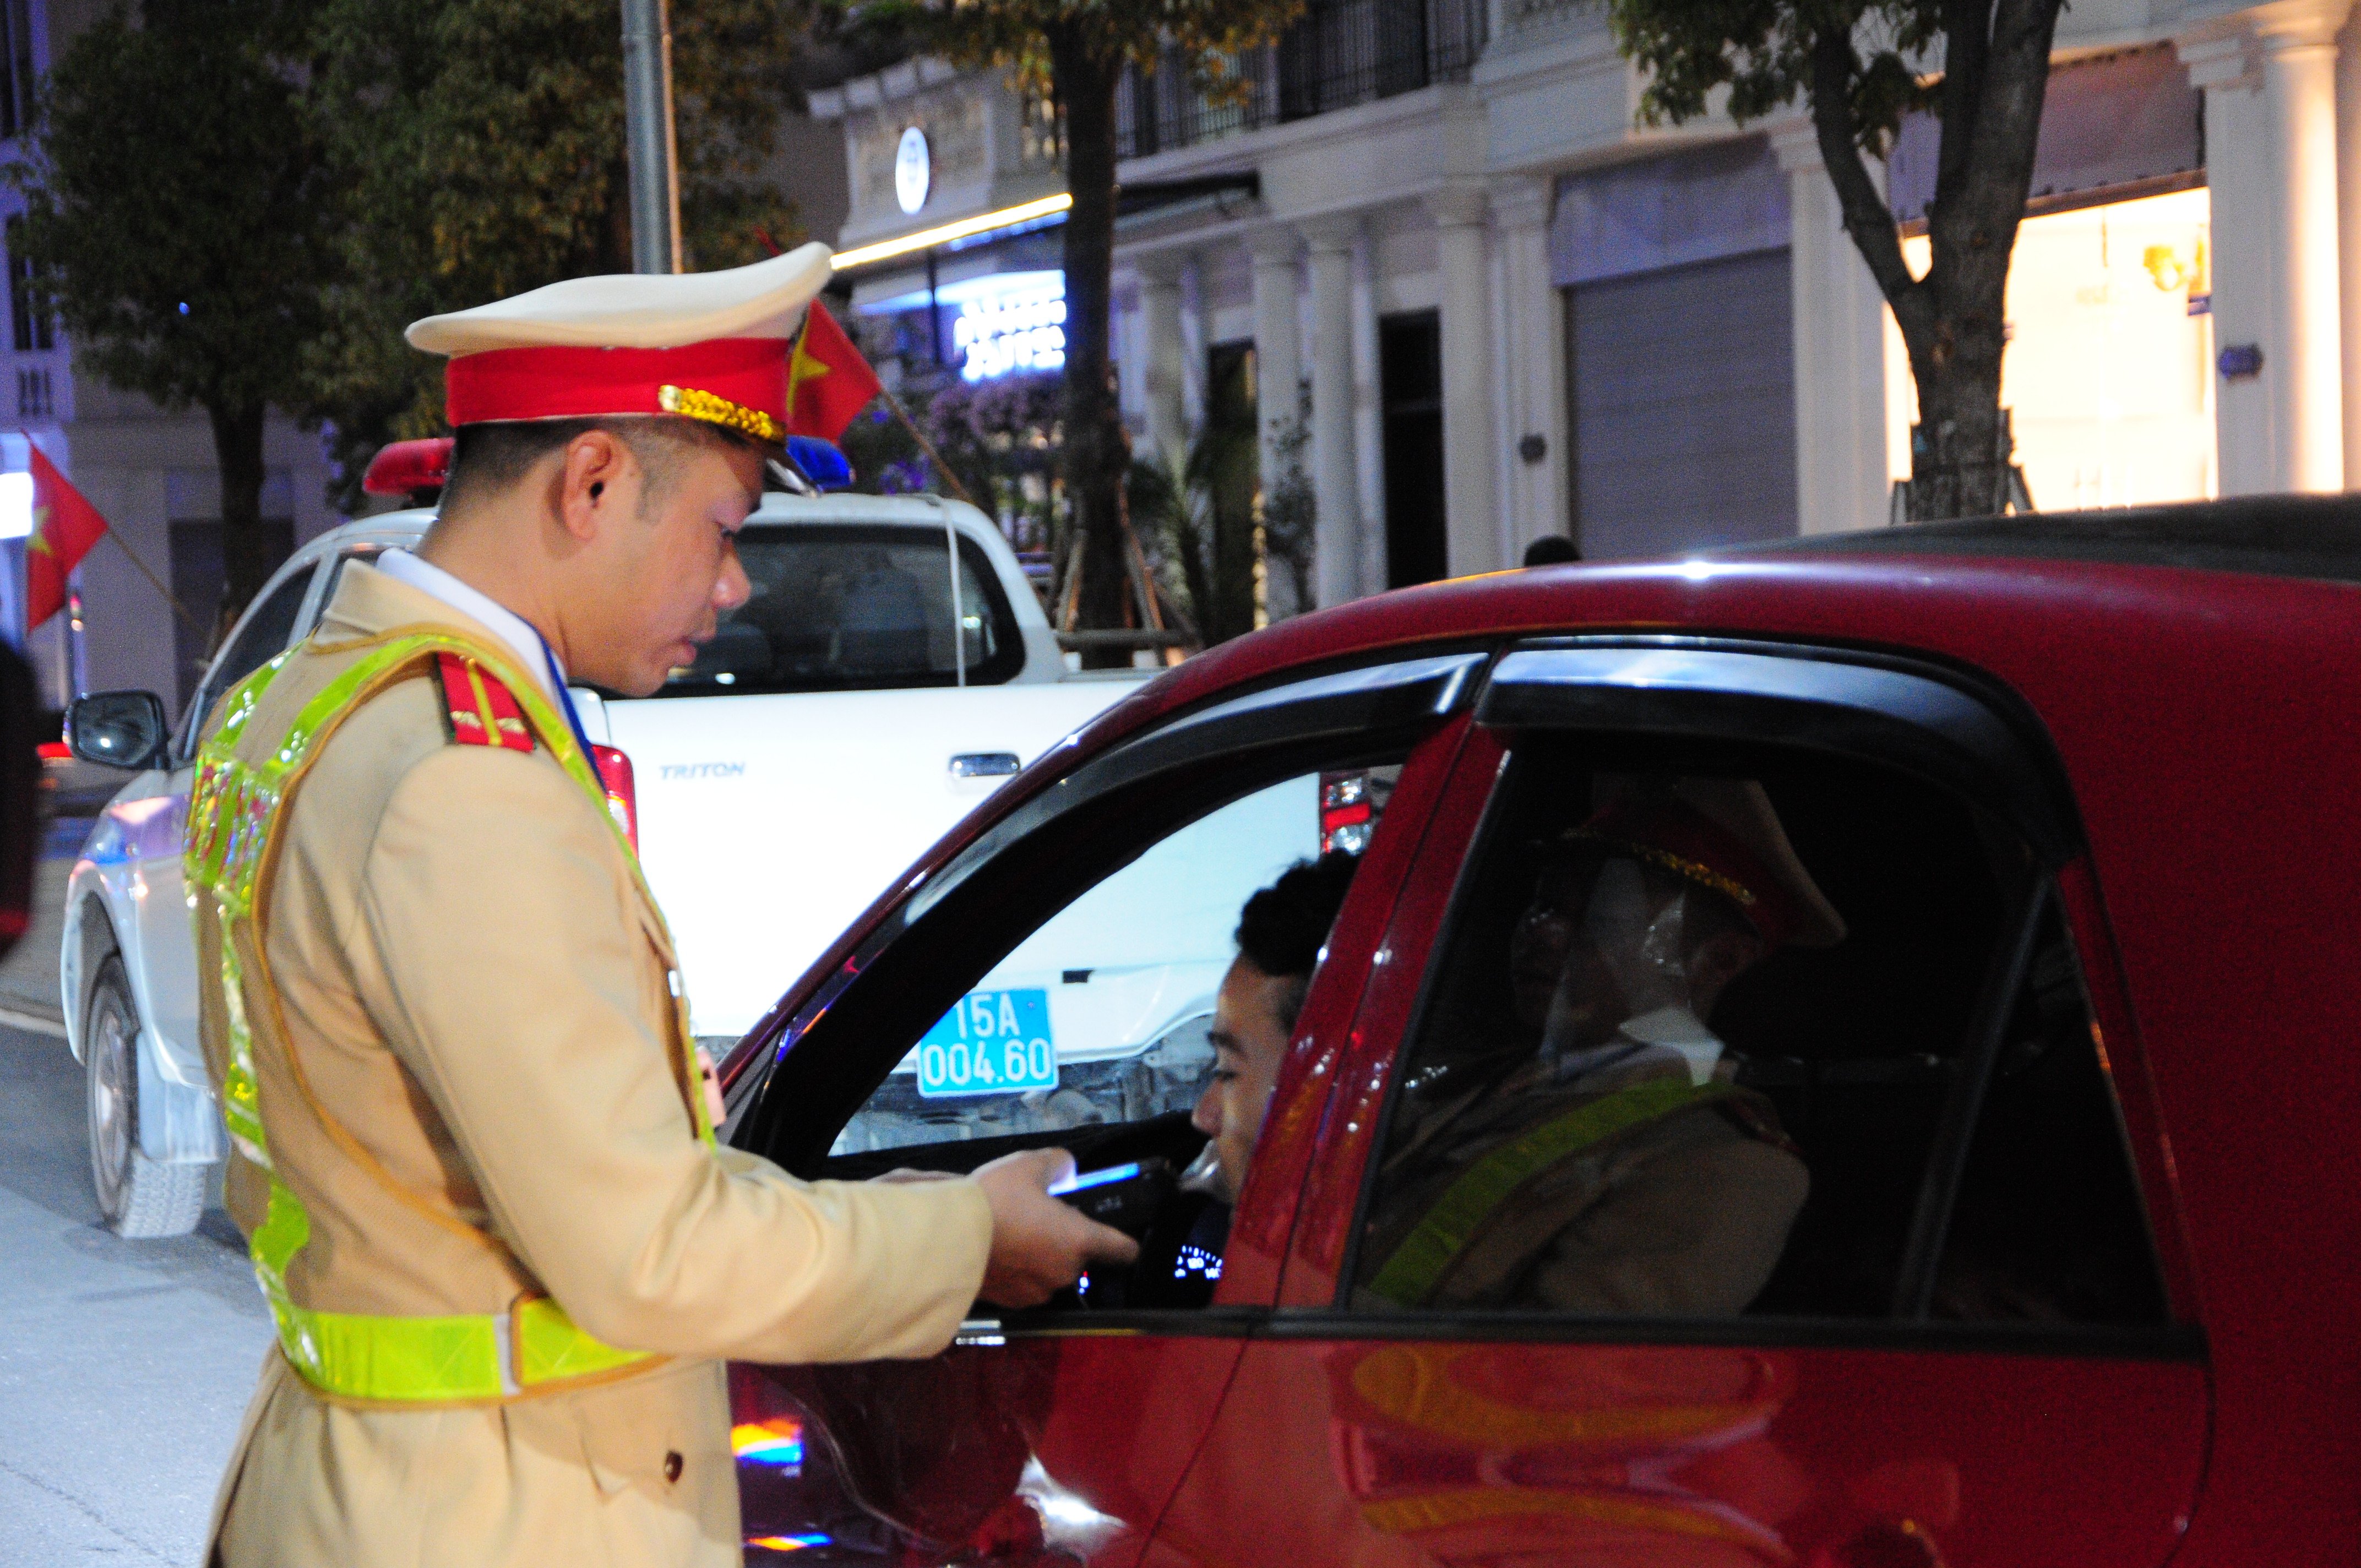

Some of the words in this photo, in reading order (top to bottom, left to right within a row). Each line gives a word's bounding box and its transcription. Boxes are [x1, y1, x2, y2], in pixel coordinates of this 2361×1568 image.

[660, 761, 745, 779] TRITON
[955, 993, 1020, 1039] 15A
[923, 1038, 1051, 1086] 004.60
